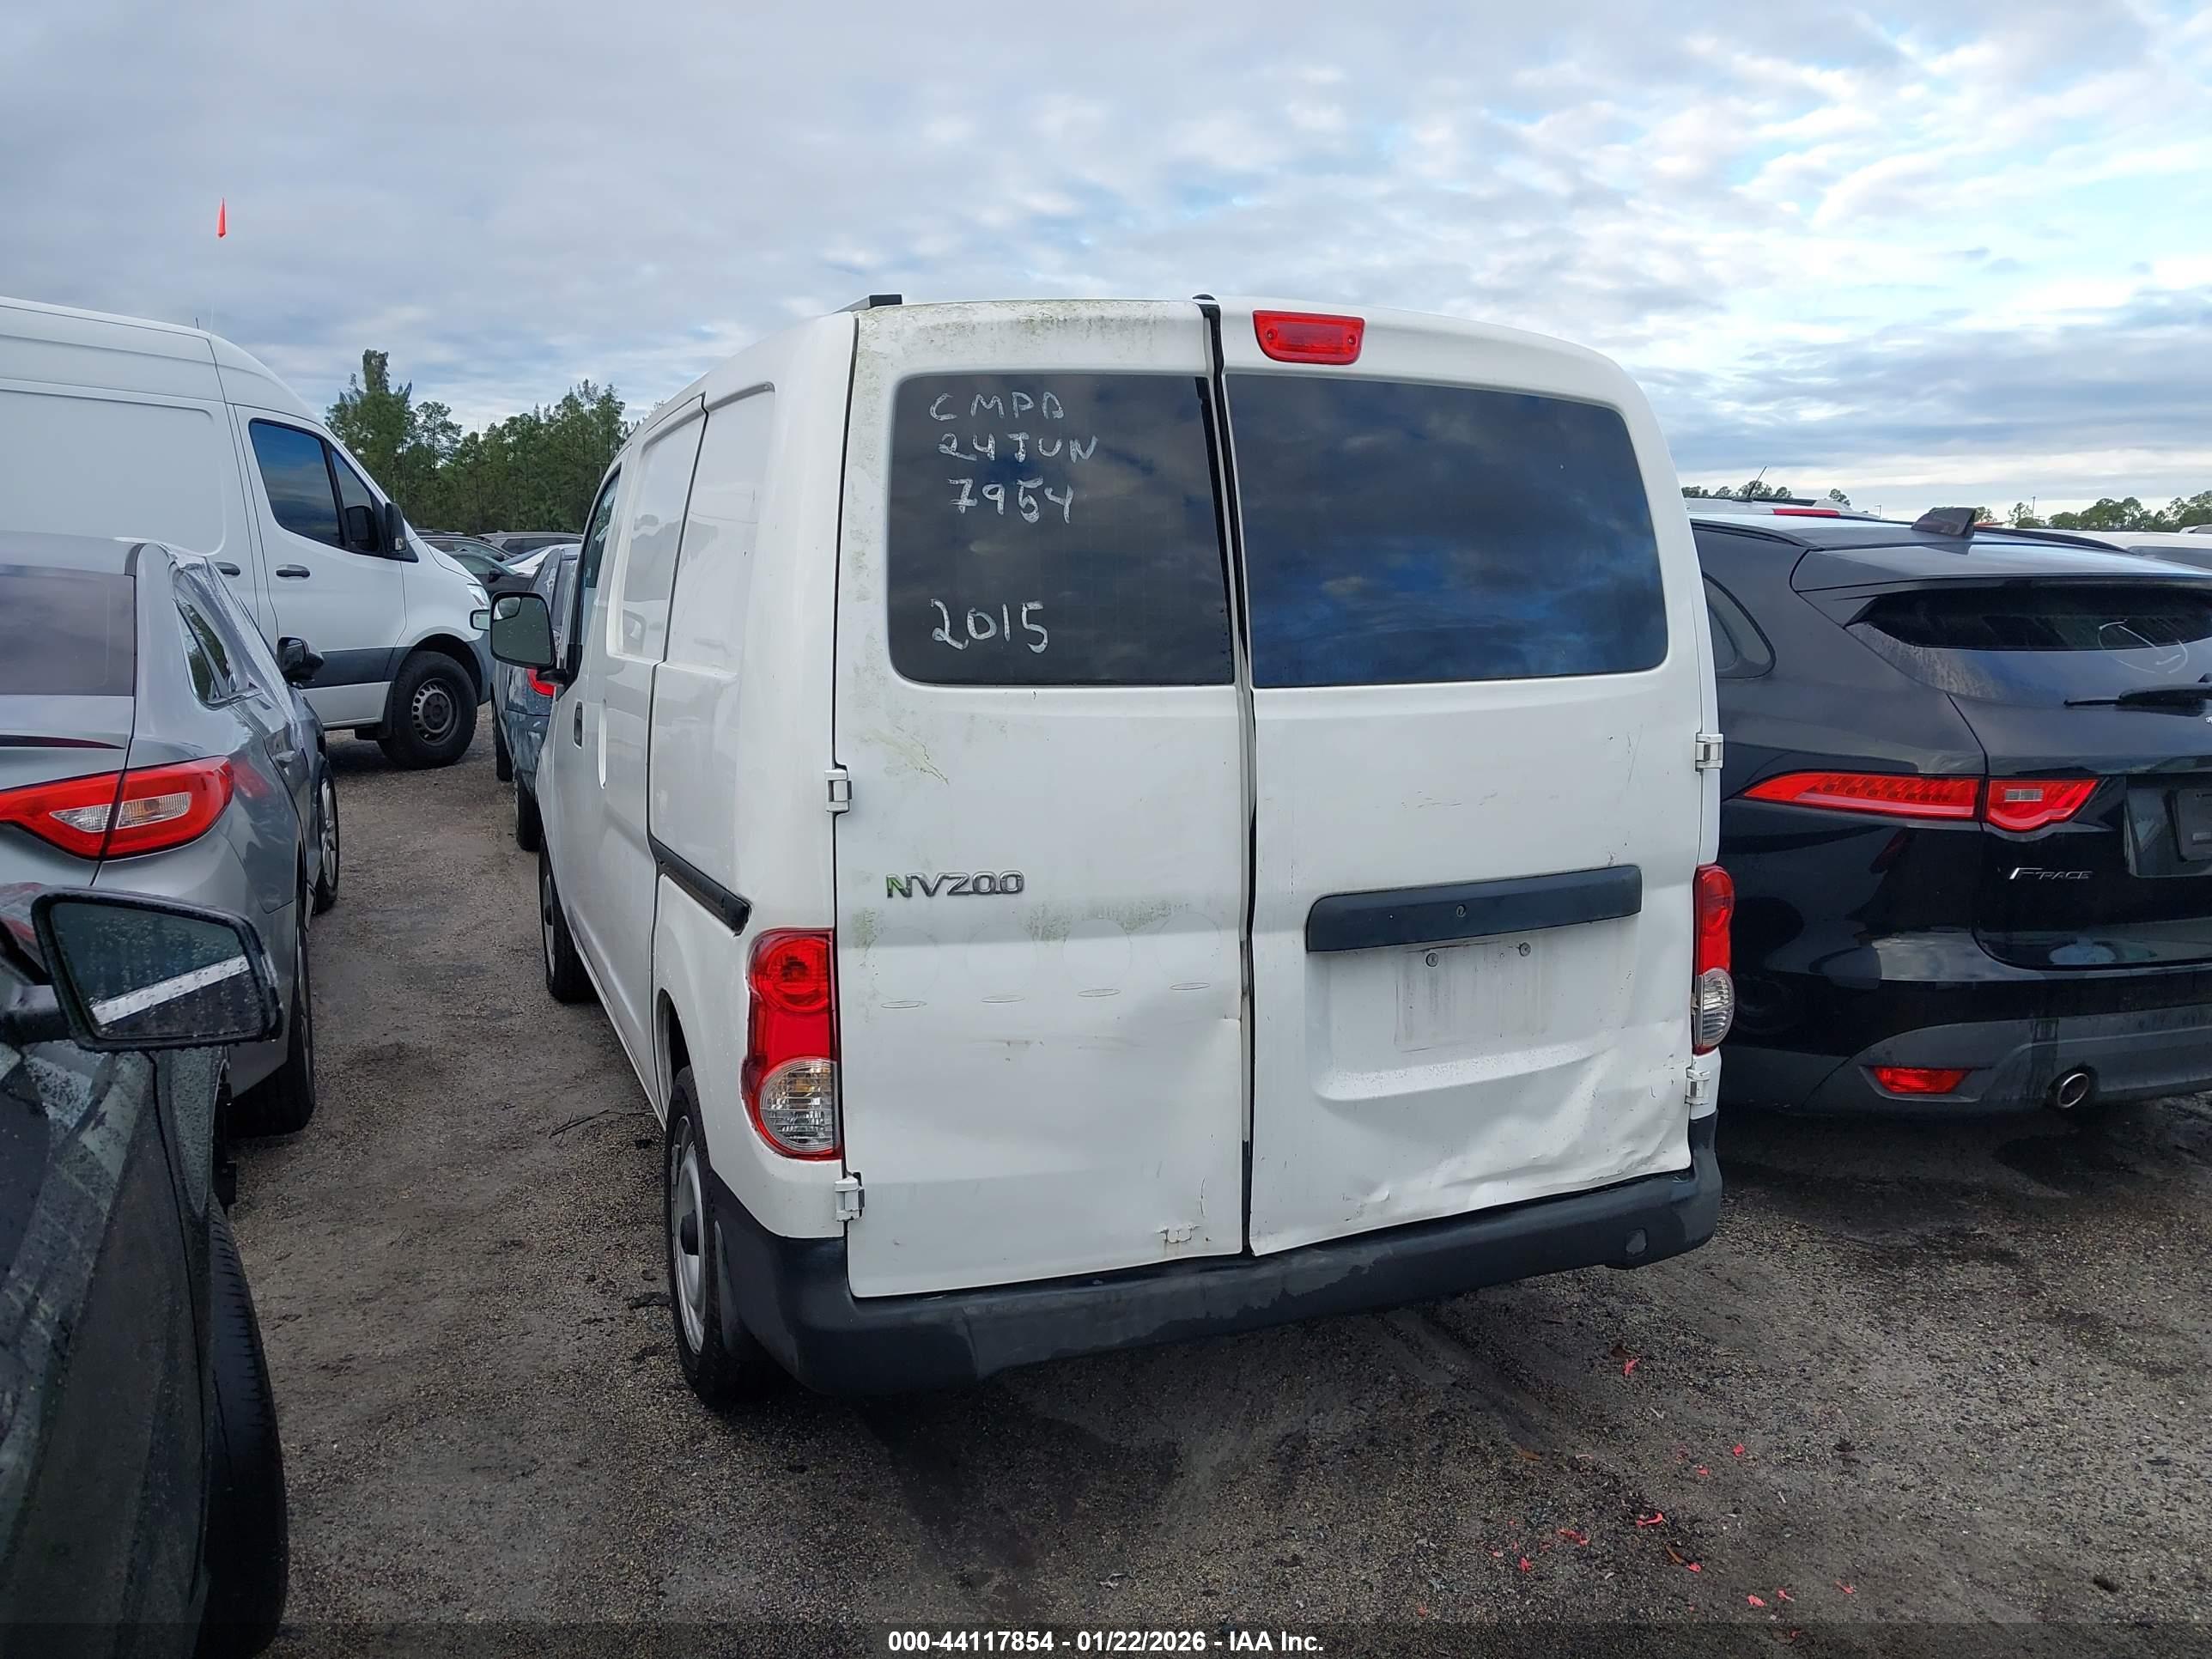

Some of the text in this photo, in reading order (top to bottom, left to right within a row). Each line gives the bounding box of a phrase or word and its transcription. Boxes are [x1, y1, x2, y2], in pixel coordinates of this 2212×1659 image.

[947, 476, 1075, 524] 7954
[930, 598, 1049, 653] 2015
[885, 870, 1025, 899] NV200
